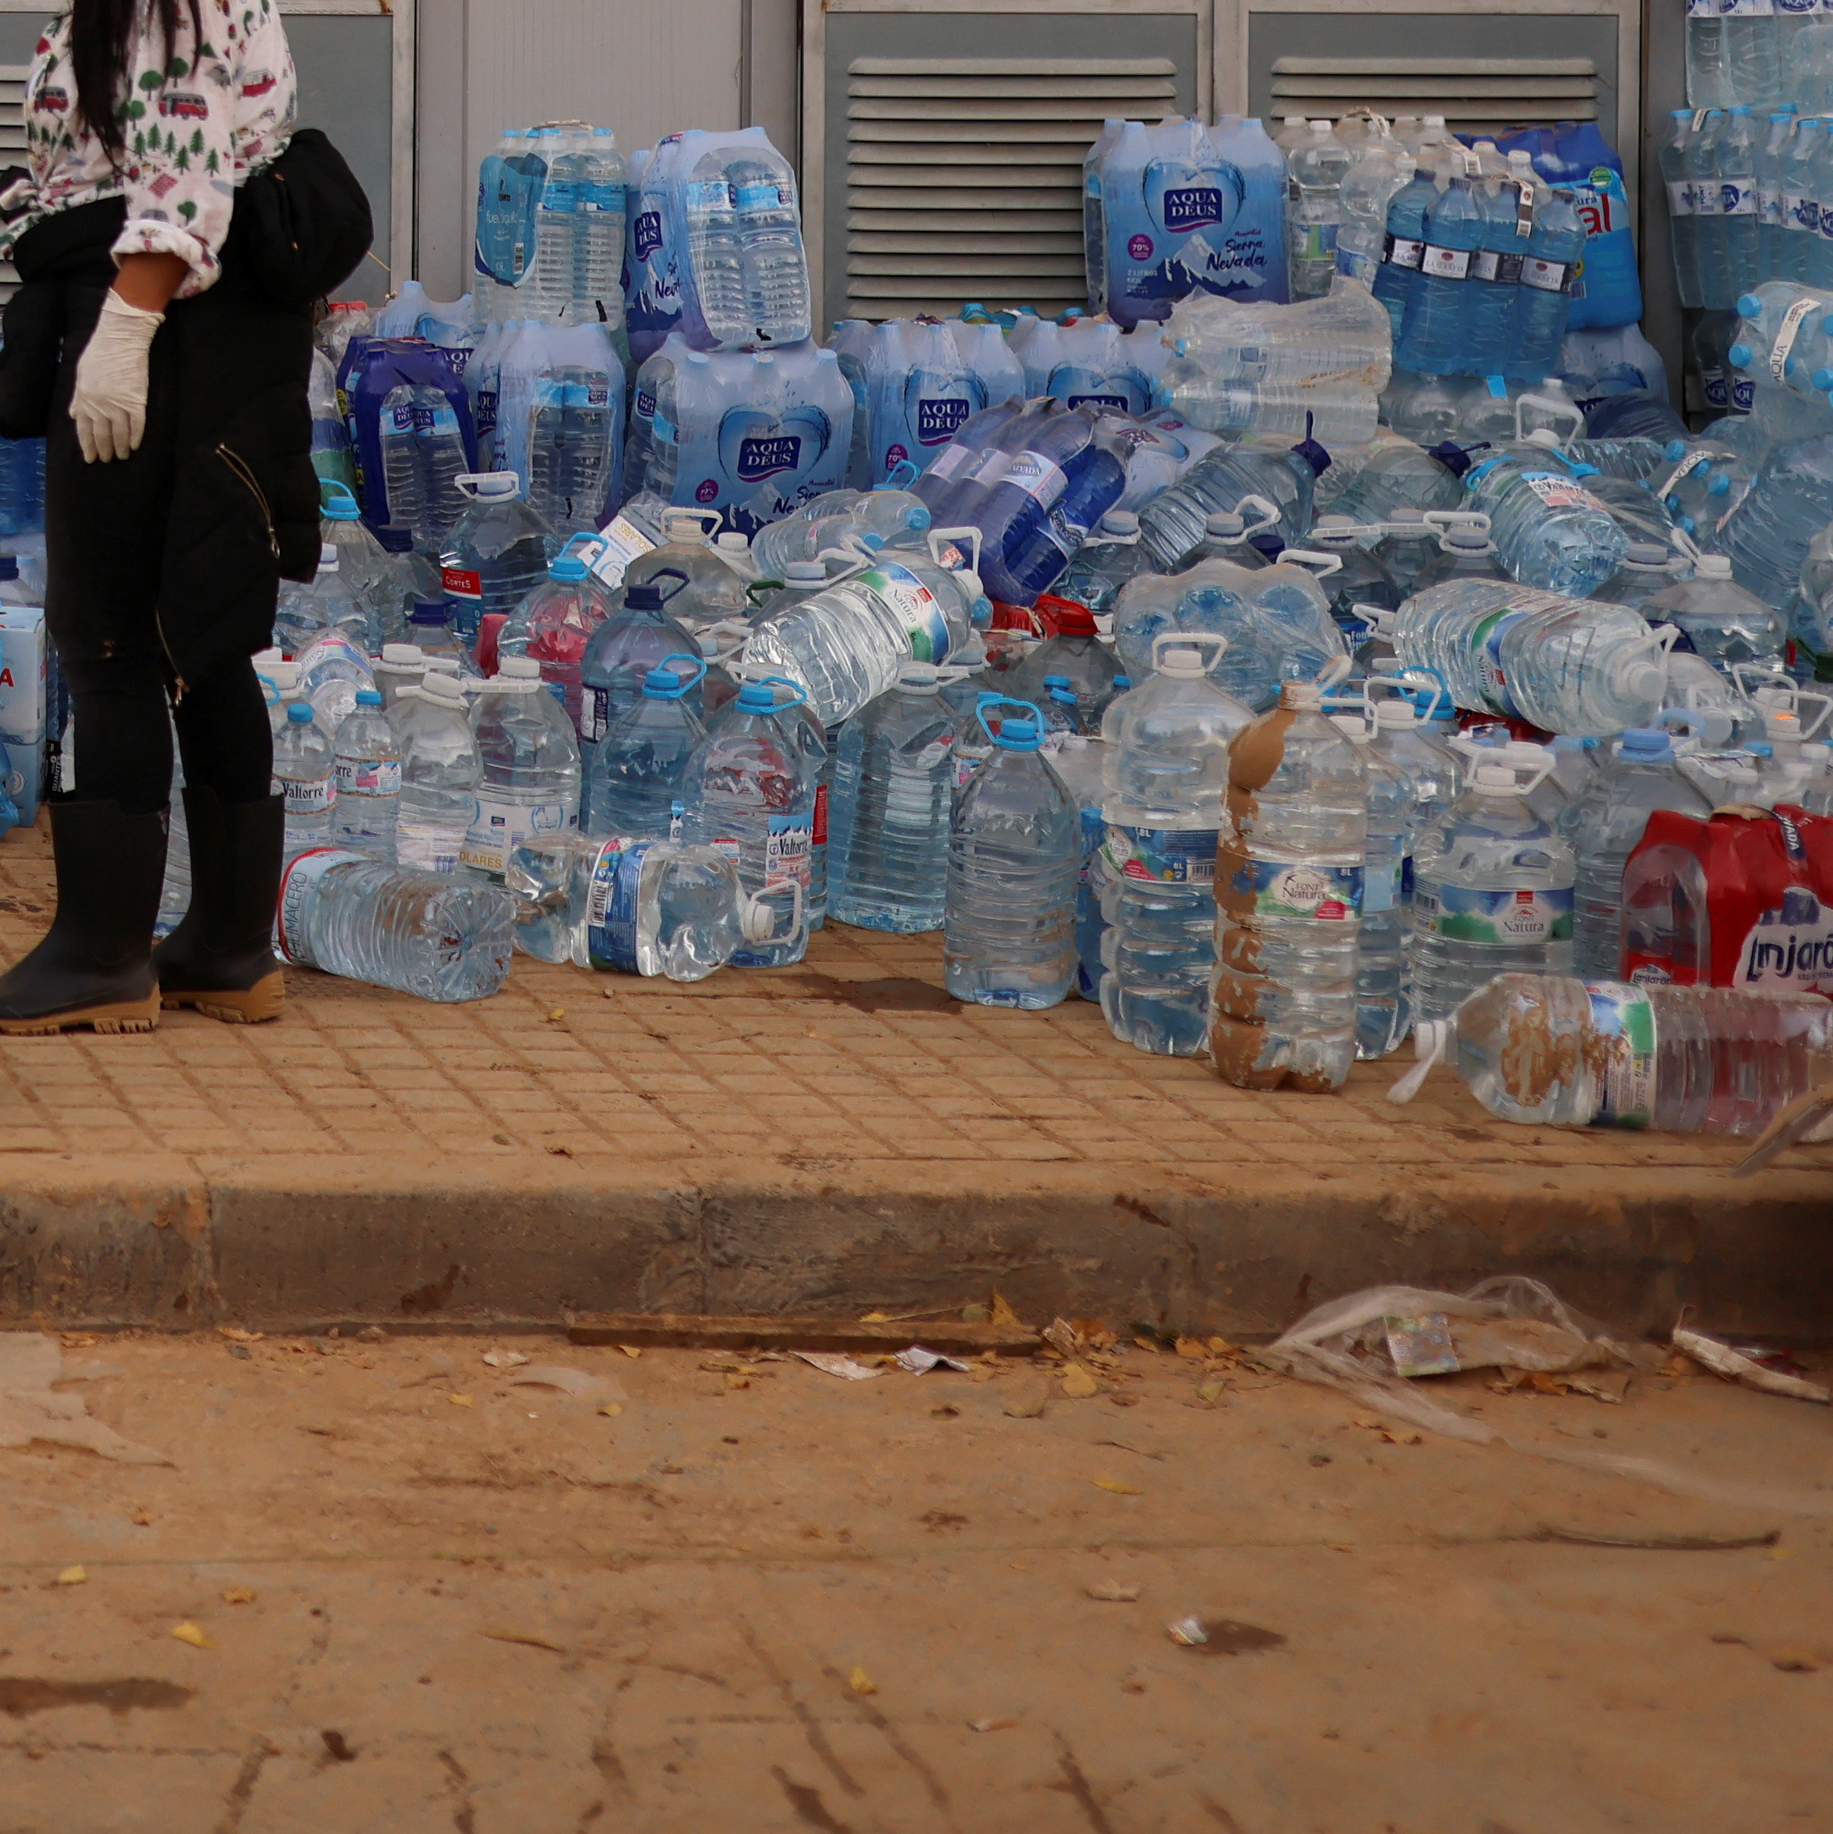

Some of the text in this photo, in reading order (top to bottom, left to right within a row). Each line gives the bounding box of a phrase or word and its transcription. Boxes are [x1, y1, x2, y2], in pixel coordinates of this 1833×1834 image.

[1169, 192, 1217, 205] AQUA
[1172, 205, 1217, 216] DEUS
[1132, 244, 1150, 252] 70%
[1225, 239, 1265, 253] Sierra
[1206, 249, 1267, 271] Nevada
[921, 404, 966, 415] AQUA
[746, 440, 796, 453] AQUA
[748, 453, 792, 465] DEUS
[445, 576, 472, 589] CORTES
[283, 782, 324, 802] Valtorre
[1283, 887, 1326, 900] Natura
[1296, 883, 1321, 891] FONT
[1503, 920, 1545, 934] Natura
